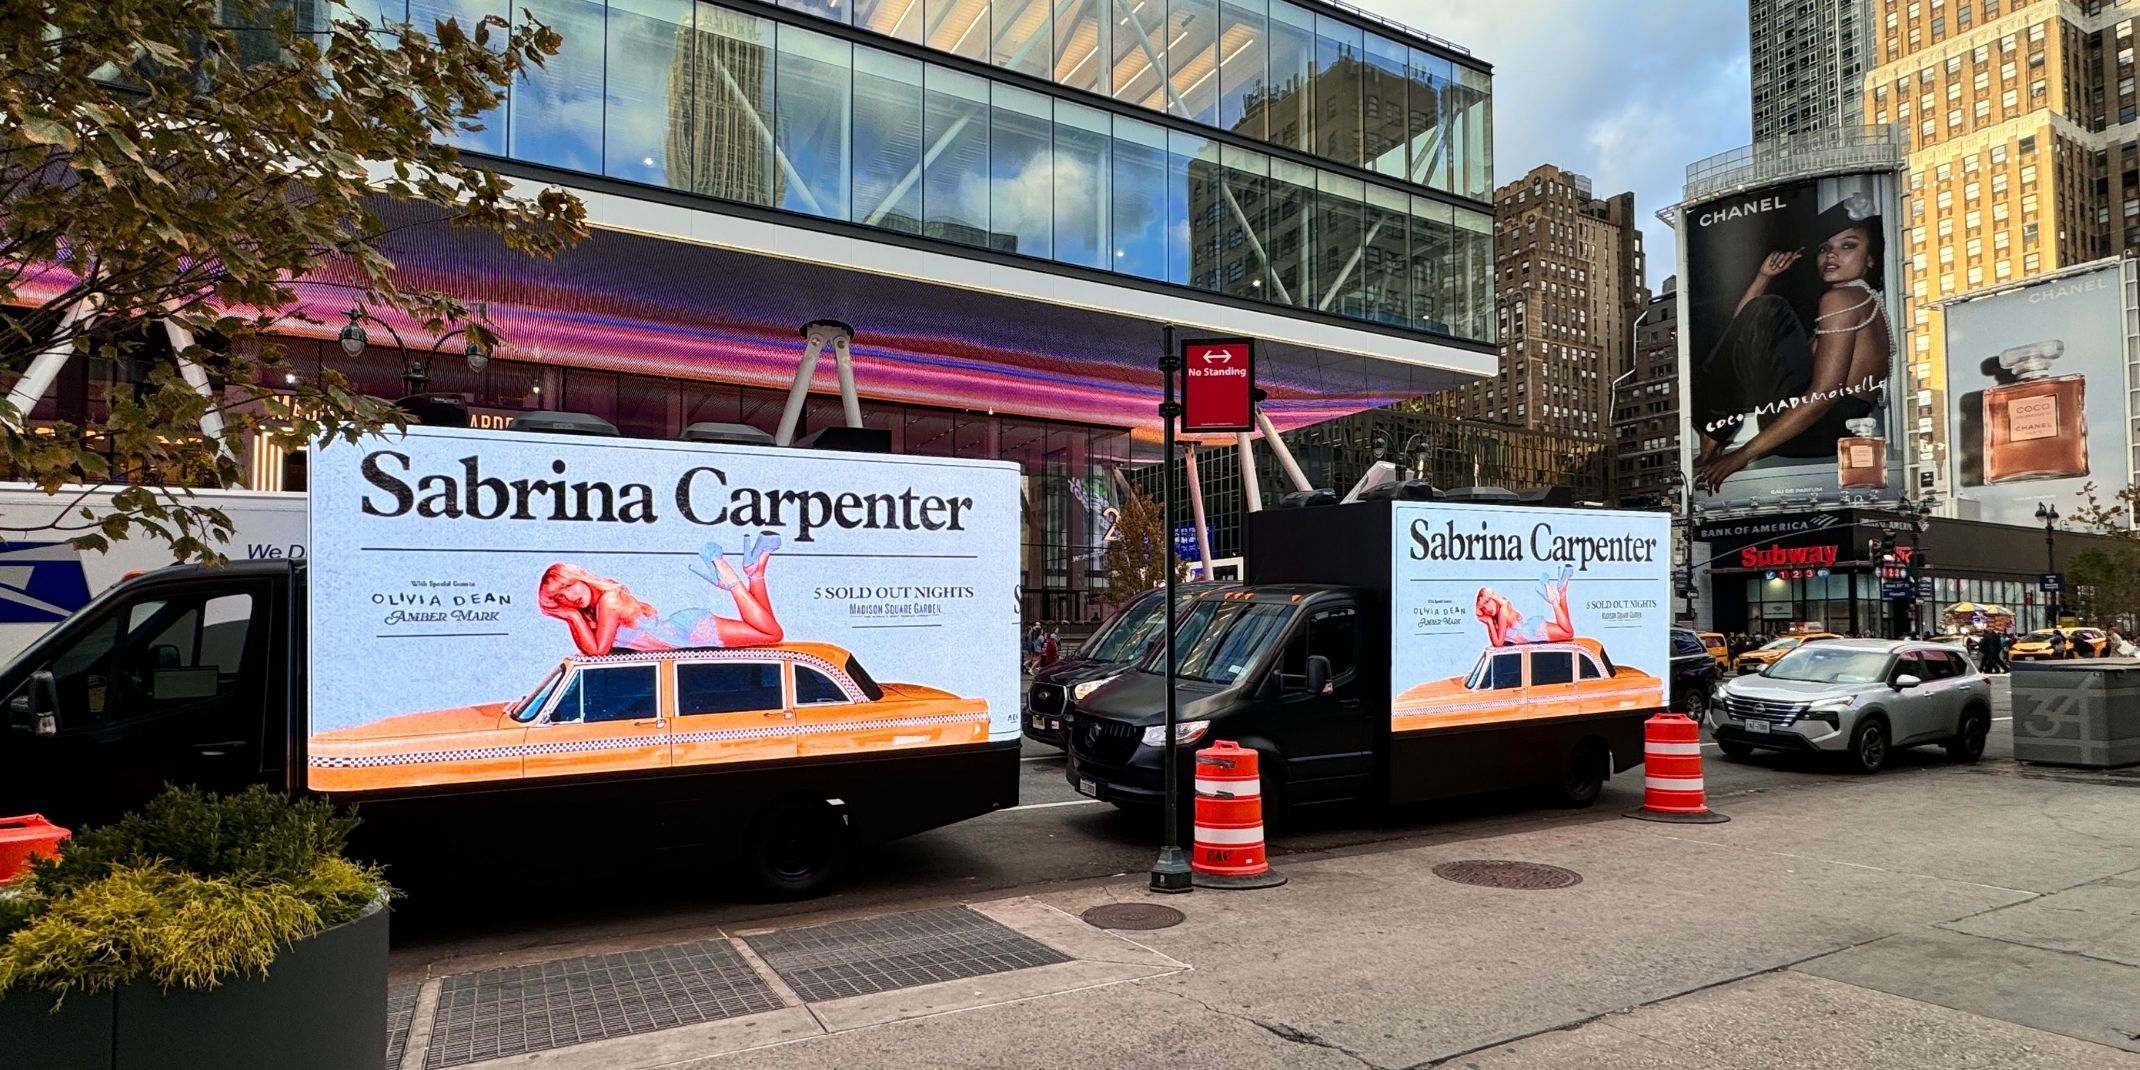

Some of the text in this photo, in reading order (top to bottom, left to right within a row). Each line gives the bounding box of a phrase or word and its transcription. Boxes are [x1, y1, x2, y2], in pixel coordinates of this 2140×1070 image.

[1699, 196, 1787, 227] CHANEL
[2028, 278, 2109, 303] CHANEL
[1188, 366, 1247, 378] No Standing
[2016, 403, 2050, 414] COCO
[2015, 422, 2053, 432] CHANEL
[360, 449, 974, 542] Sabrina Carpenter
[1701, 521, 1809, 538] BANK OF AMERICA
[248, 544, 282, 559] We
[1410, 518, 1657, 571] Sabrina Carpenter
[1741, 544, 1839, 567] Subway
[372, 592, 511, 606] OLIVIA DEAN
[813, 586, 975, 600] 5 SOLD OUT NIGHTS
[850, 602, 942, 615] MADISON SQUARE GARDEN
[1413, 606, 1466, 615] OLIVIA DEAN
[1586, 600, 1657, 609] 5 SOLD OUT NIGHTS
[384, 610, 500, 625] AMBER MARK
